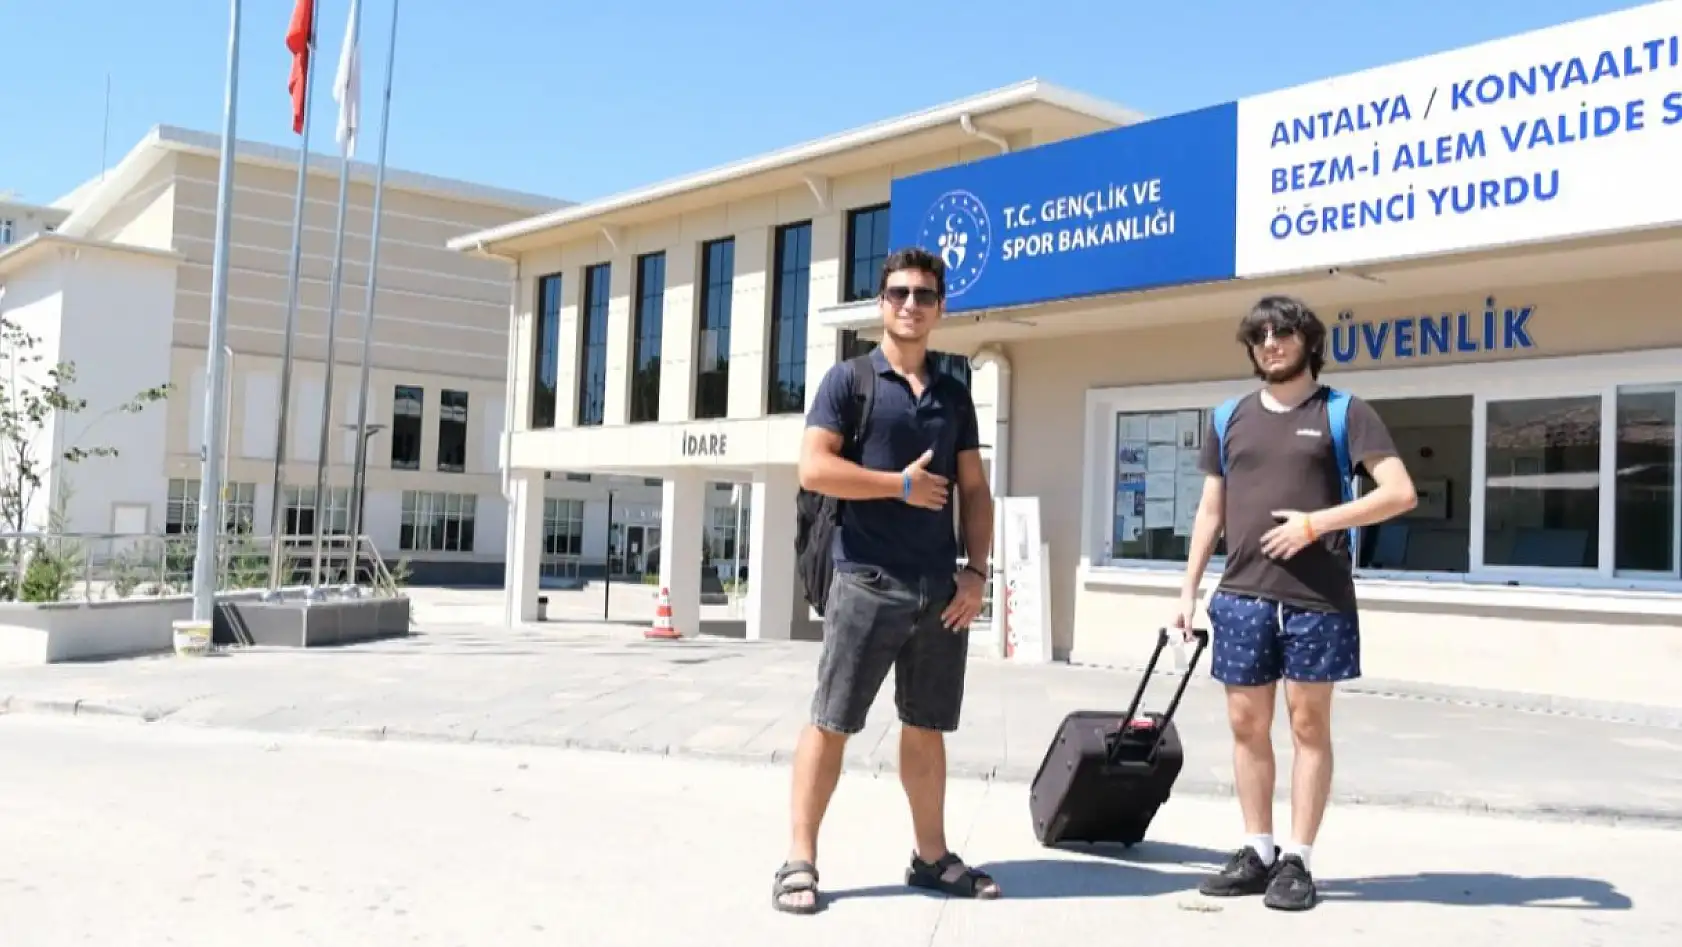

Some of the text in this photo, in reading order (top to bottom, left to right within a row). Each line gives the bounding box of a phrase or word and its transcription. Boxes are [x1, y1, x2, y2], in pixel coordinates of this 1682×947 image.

[1271, 94, 1411, 148] ANTALYA
[1452, 35, 1679, 110] KONYAALTI
[1271, 141, 1380, 194] BEZM-İ
[1392, 130, 1487, 173] ALEM
[1501, 101, 1645, 153] VALİDE
[1002, 206, 1175, 262] SPOR BAKANLIĞI
[1003, 179, 1162, 230] T.C. GENÇLİK VE
[1270, 169, 1560, 240] ÖĞRENCİ YURDU
[1325, 295, 1537, 363] ÜVENLİK
[682, 430, 727, 456] İDARE
